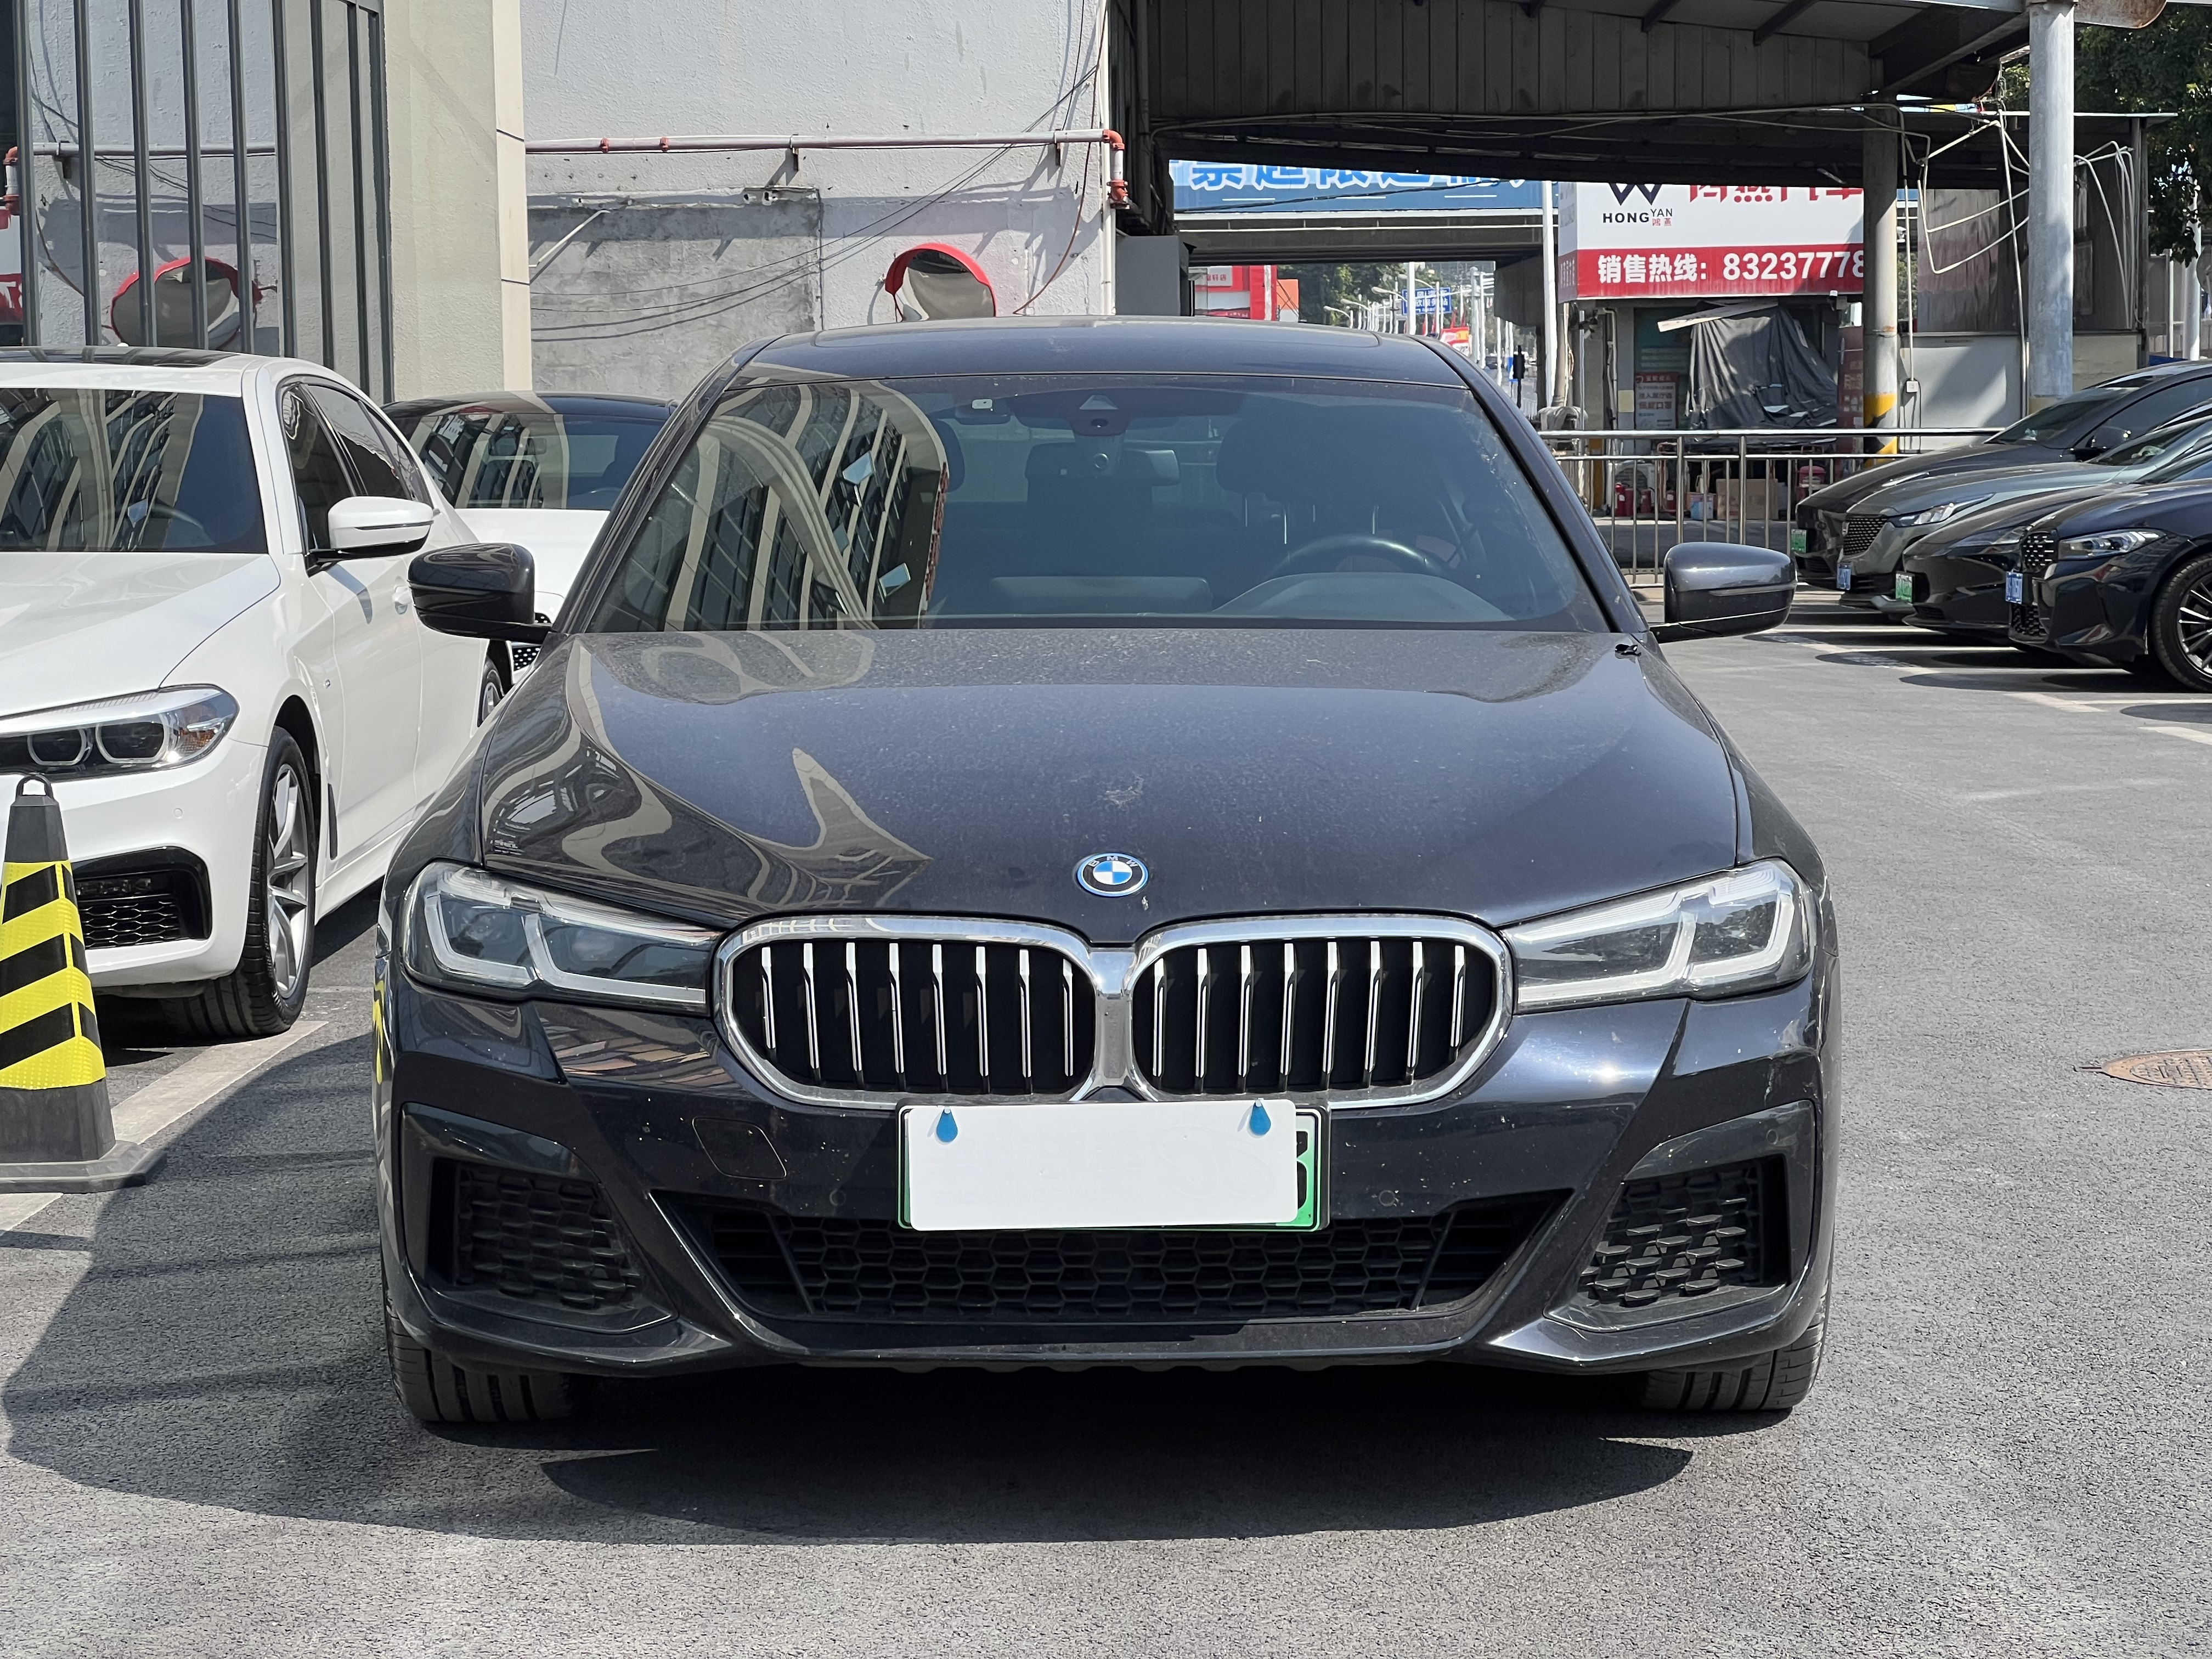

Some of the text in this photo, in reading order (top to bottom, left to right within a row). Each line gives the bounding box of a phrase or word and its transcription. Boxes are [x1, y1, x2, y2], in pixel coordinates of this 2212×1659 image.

[1602, 208, 1672, 223] HONG YAN
[1723, 250, 1864, 280] 83237778
[1088, 855, 1138, 867] BMW
